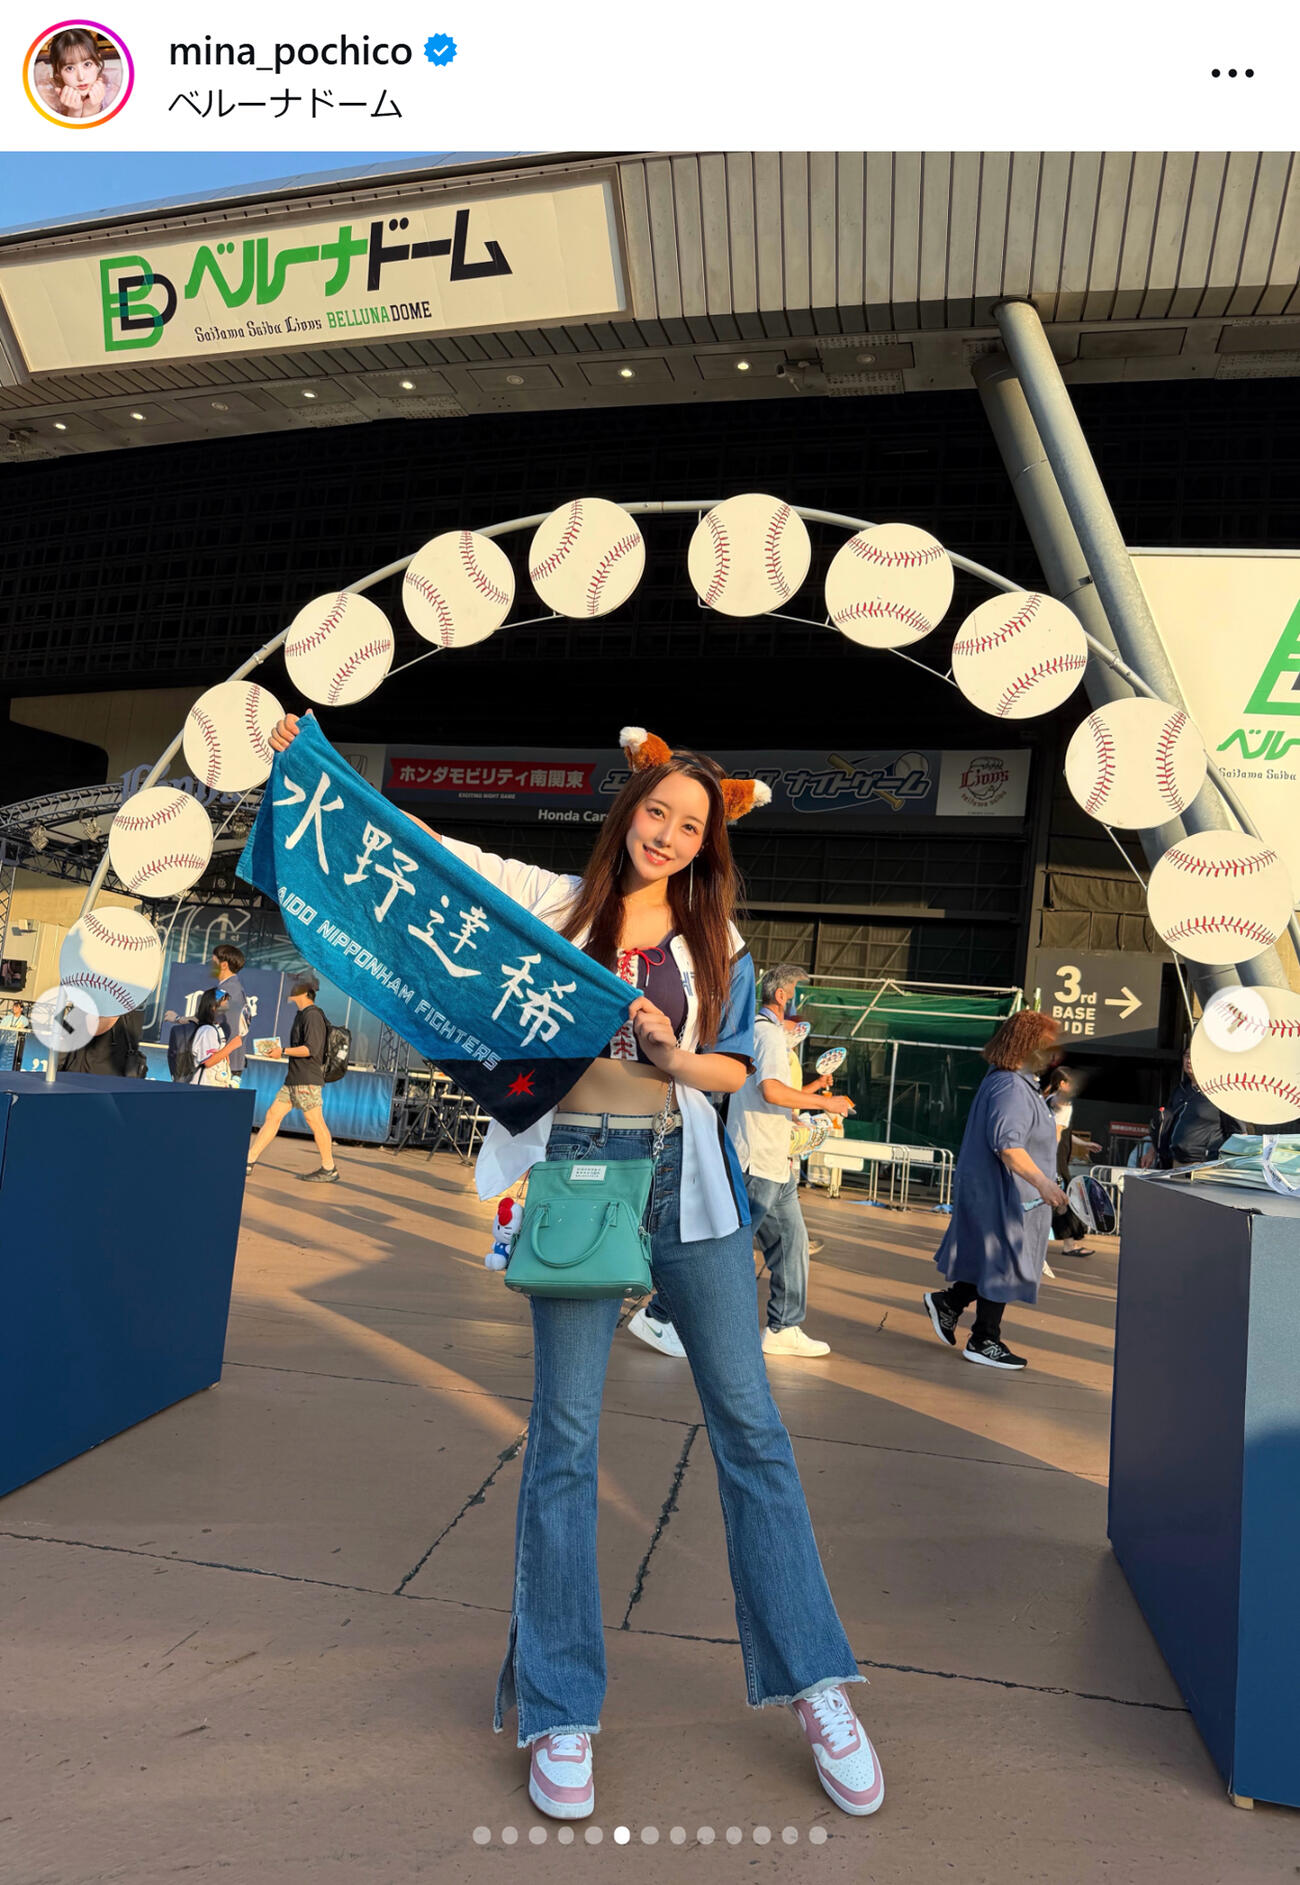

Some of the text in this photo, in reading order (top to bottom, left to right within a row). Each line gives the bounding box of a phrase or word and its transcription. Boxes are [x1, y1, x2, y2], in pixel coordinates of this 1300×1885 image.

[183, 208, 513, 309] ベルーナドーム
[194, 325, 245, 343] Saitama
[285, 315, 323, 333] Lions
[1216, 728, 1300, 760] ベル
[399, 765, 585, 789] ホンダモビリティ南関東
[537, 808, 580, 822] Honda
[316, 919, 416, 1006] NIPPONHAM
[414, 999, 502, 1072] FIGHTERS
[1053, 965, 1097, 1004] 3rd
[1052, 1005, 1096, 1020] BASE
[1056, 1020, 1096, 1035] IDE
